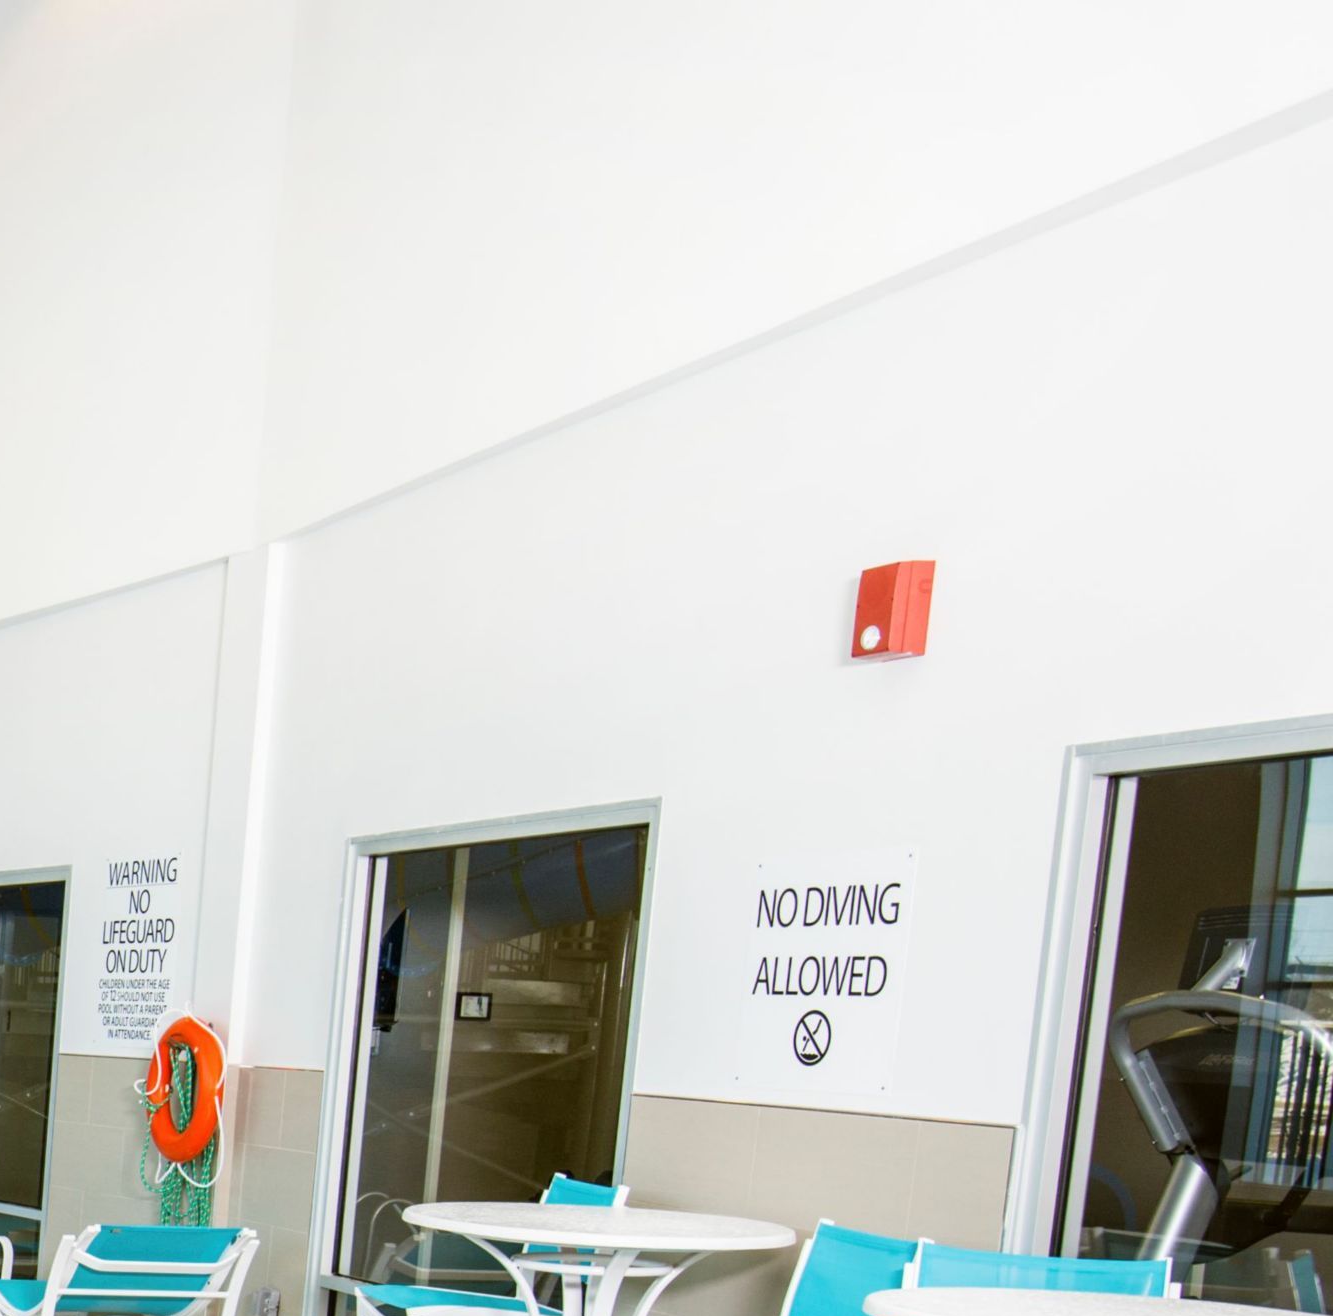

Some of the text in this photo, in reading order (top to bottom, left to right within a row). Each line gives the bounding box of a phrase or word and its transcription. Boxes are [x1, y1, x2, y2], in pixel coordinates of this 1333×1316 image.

[109, 857, 178, 886] WARNING
[129, 889, 151, 914] NO
[757, 883, 901, 928] NO DIVING
[102, 918, 175, 944] LIFEGUARD
[106, 949, 167, 973] ON DUTY
[99, 979, 170, 990] CHILDREN UNDER THE AGE
[752, 956, 888, 996] ALLOWED
[101, 990, 165, 1002] OF 12 SHOULD NOT USE
[98, 1003, 112, 1014] POOL
[113, 1004, 139, 1014] WITHOUT
[144, 1004, 167, 1015] PARENT
[102, 1016, 110, 1026] OR
[111, 1016, 129, 1027] ADULT
[107, 1029, 113, 1039] IN
